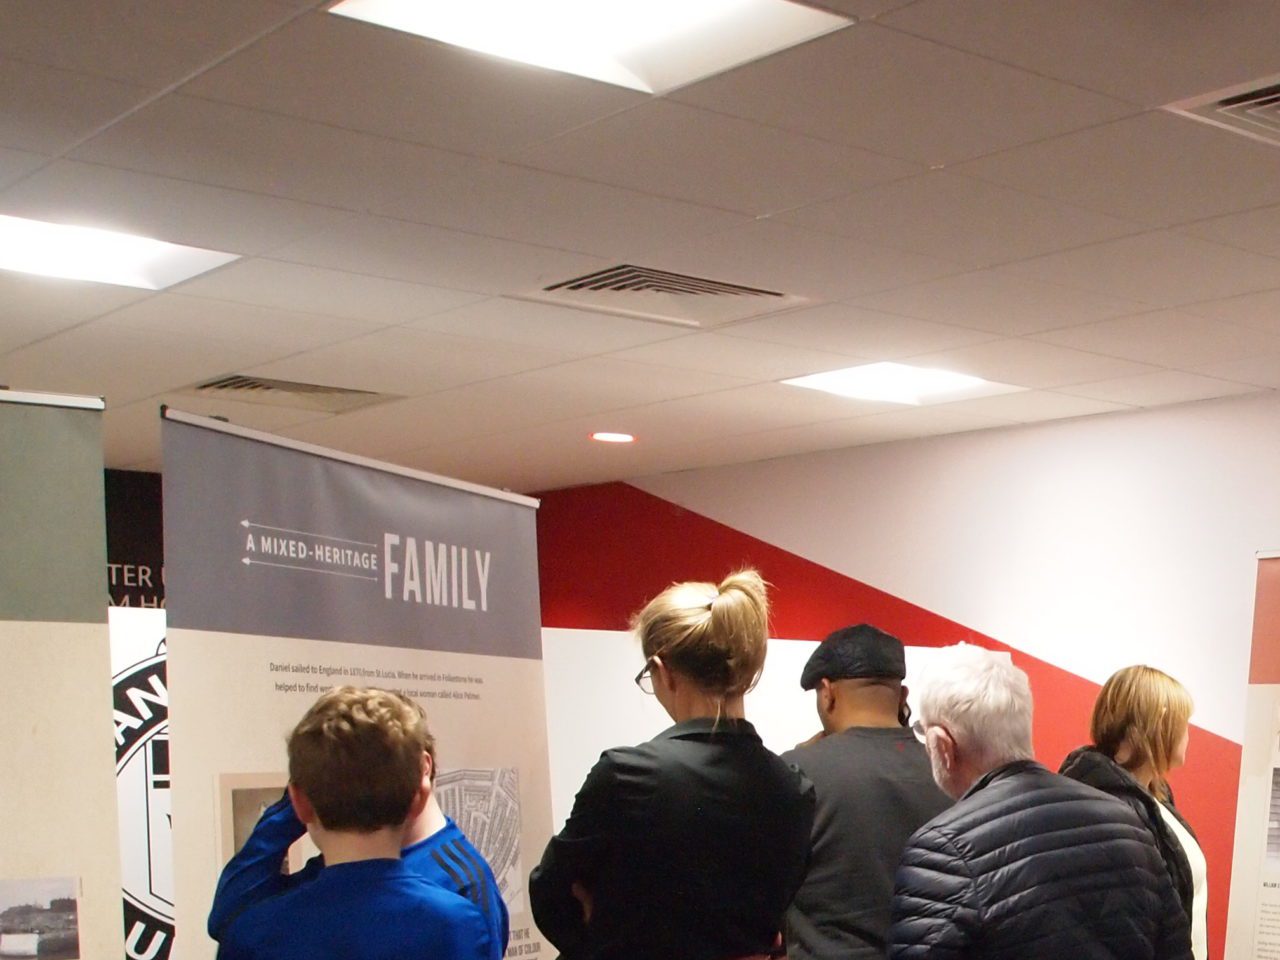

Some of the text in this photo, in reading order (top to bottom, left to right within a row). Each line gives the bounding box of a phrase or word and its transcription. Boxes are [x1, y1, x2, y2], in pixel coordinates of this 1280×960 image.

[246, 533, 490, 612] A MIXED-HERITAGE FAMILY
[270, 662, 290, 673] Daniel
[292, 664, 310, 674] sailed
[311, 666, 318, 674] to
[319, 665, 342, 677] England
[275, 682, 297, 693] helped
